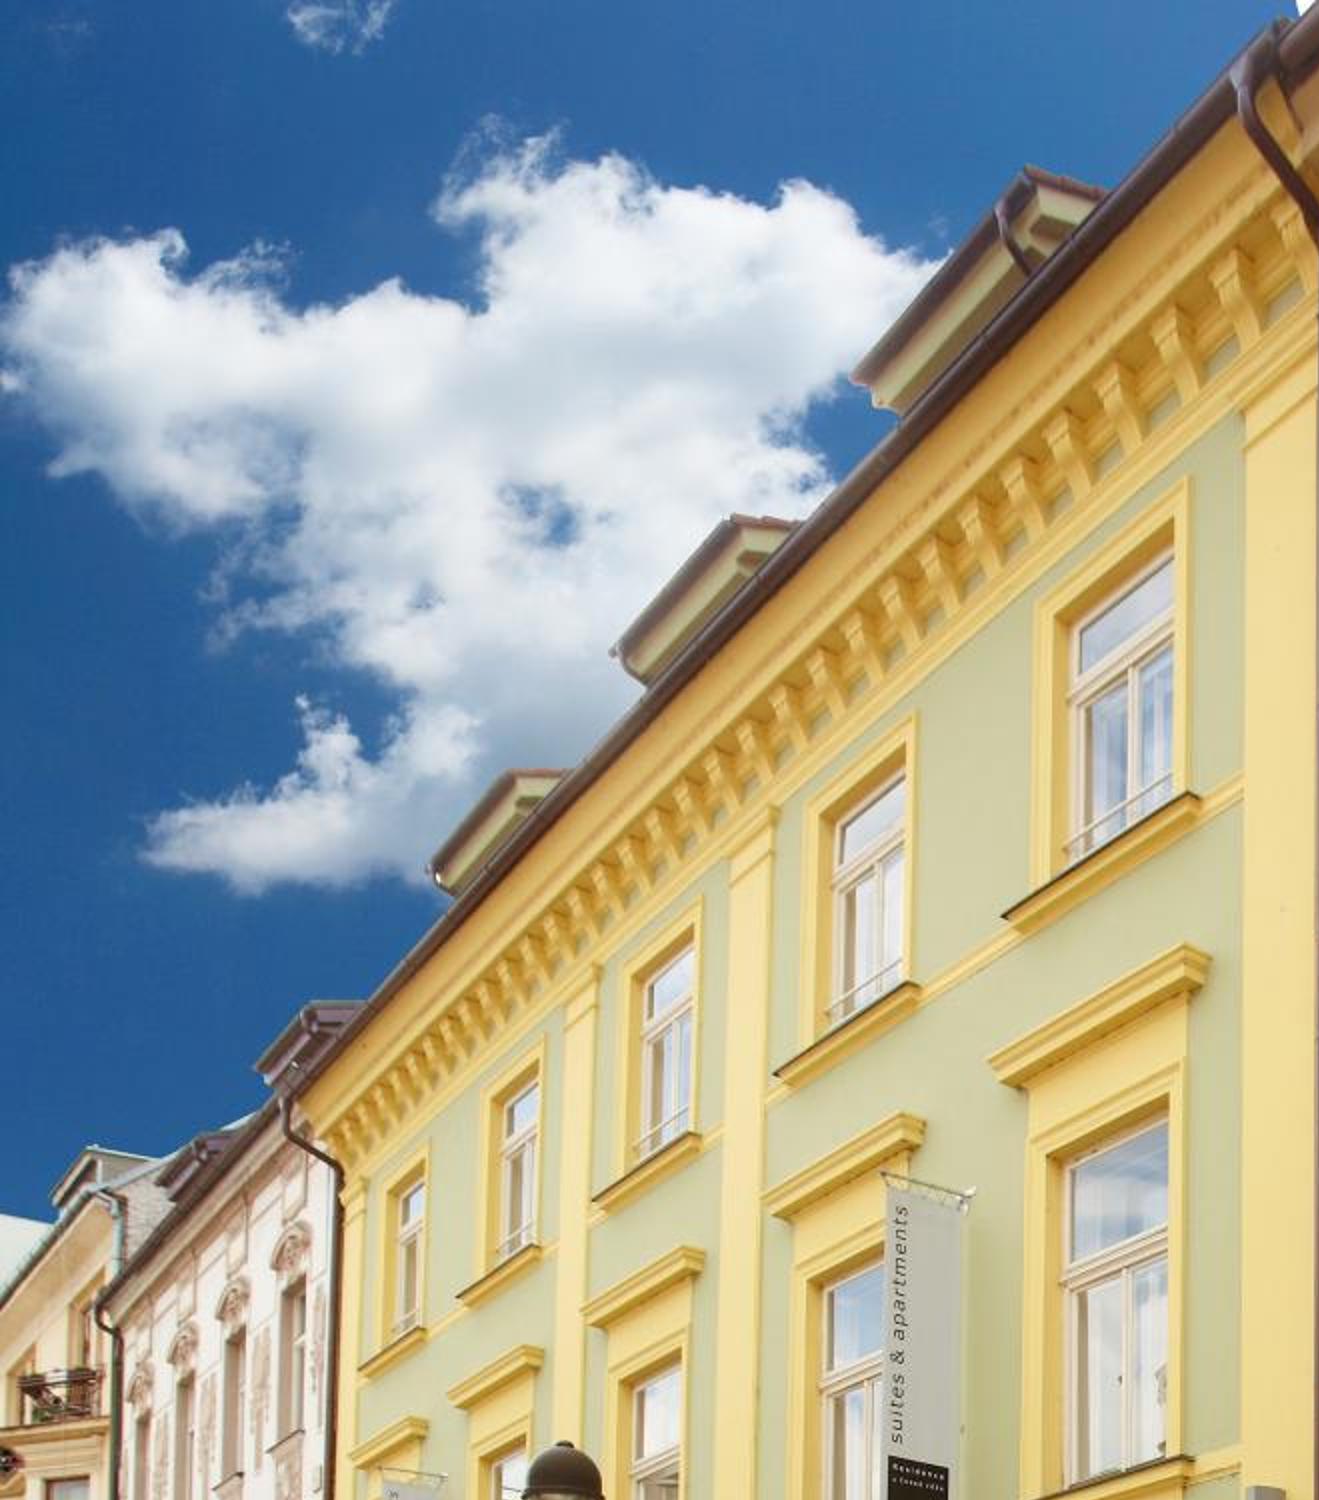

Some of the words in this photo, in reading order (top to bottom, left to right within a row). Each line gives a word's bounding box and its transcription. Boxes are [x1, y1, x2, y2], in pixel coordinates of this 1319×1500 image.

[893, 1205, 909, 1341] apartments
[890, 1350, 905, 1365] &
[891, 1372, 906, 1444] suites
